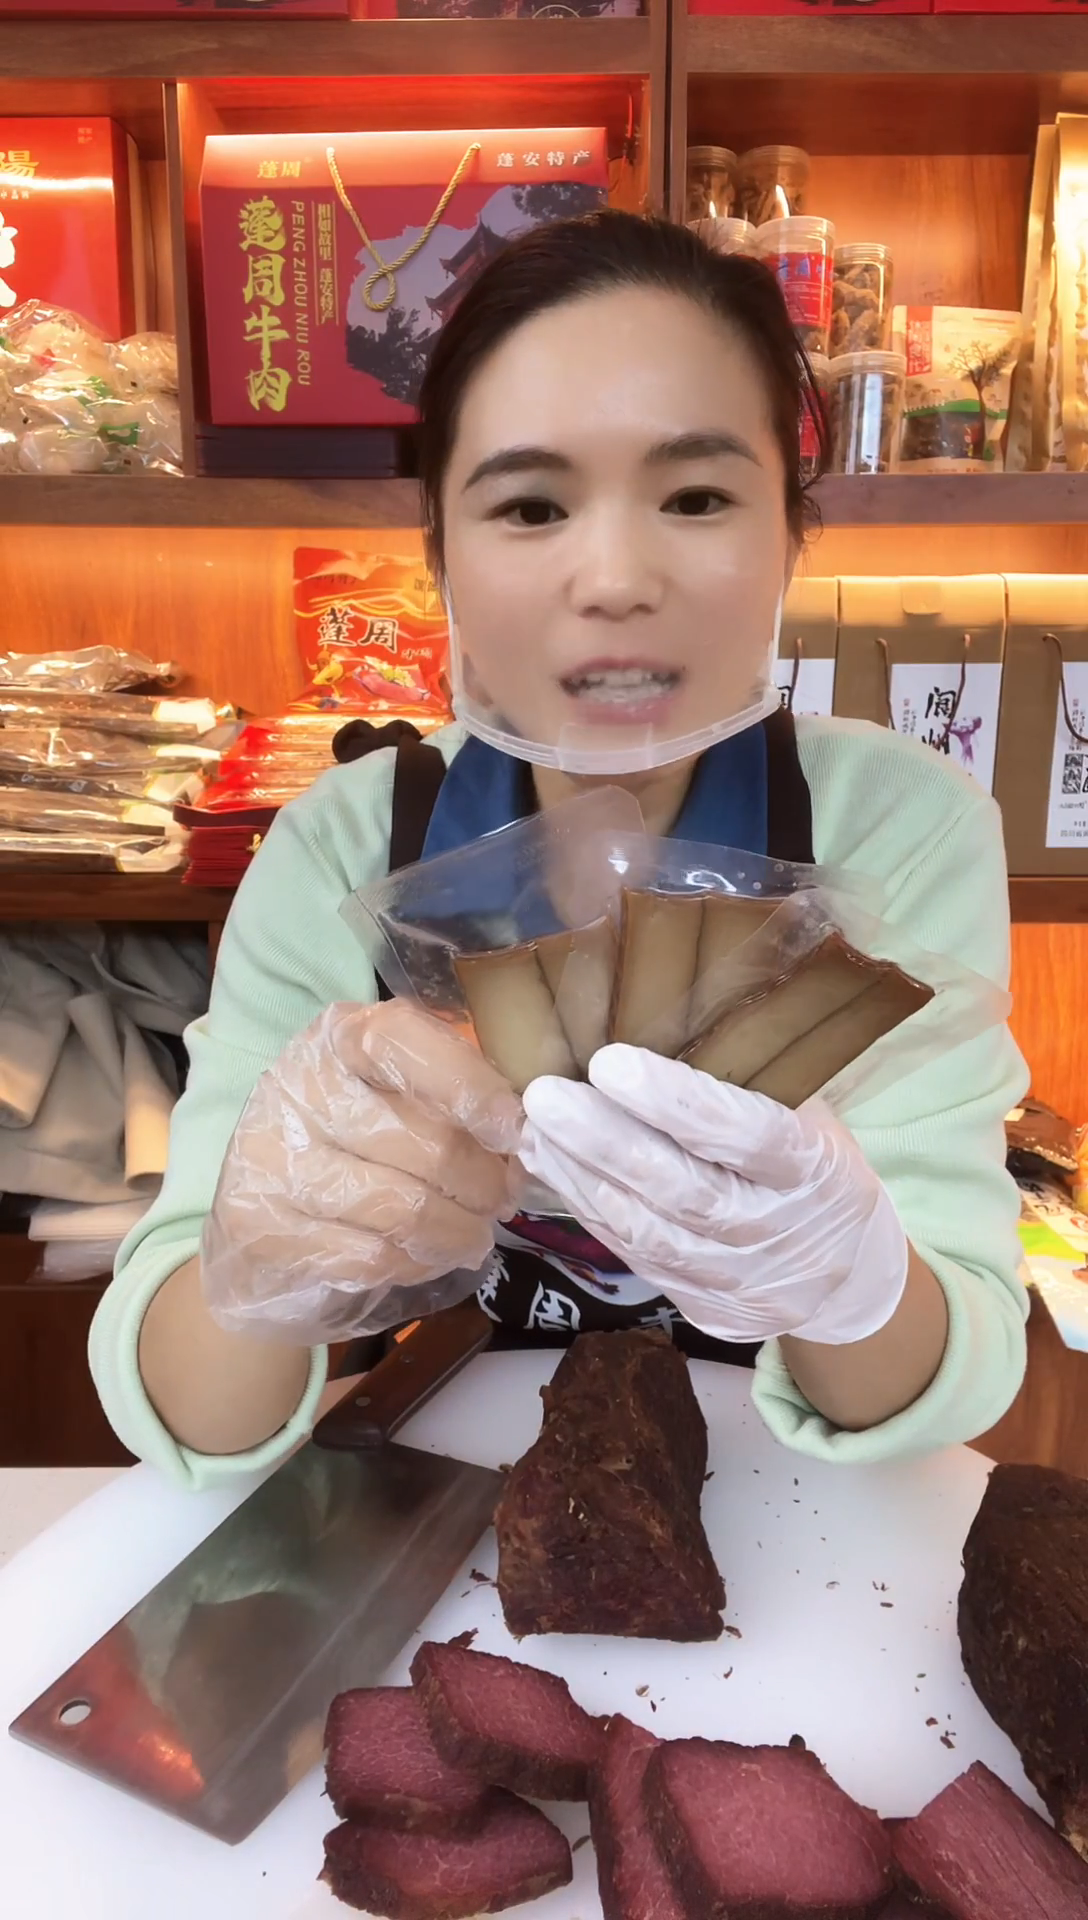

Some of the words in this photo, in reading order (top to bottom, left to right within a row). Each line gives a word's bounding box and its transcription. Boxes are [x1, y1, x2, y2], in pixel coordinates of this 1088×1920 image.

[256, 160, 301, 179] 蓬周
[496, 150, 591, 168] 蓬安特产
[291, 200, 306, 252] PENG
[238, 195, 292, 412] 蓬周牛肉
[293, 258, 308, 308] ZHOU
[319, 267, 335, 325] 蓬安特产
[295, 312, 309, 345] NIU
[297, 349, 311, 386] ROU
[317, 604, 399, 654] 蓬周
